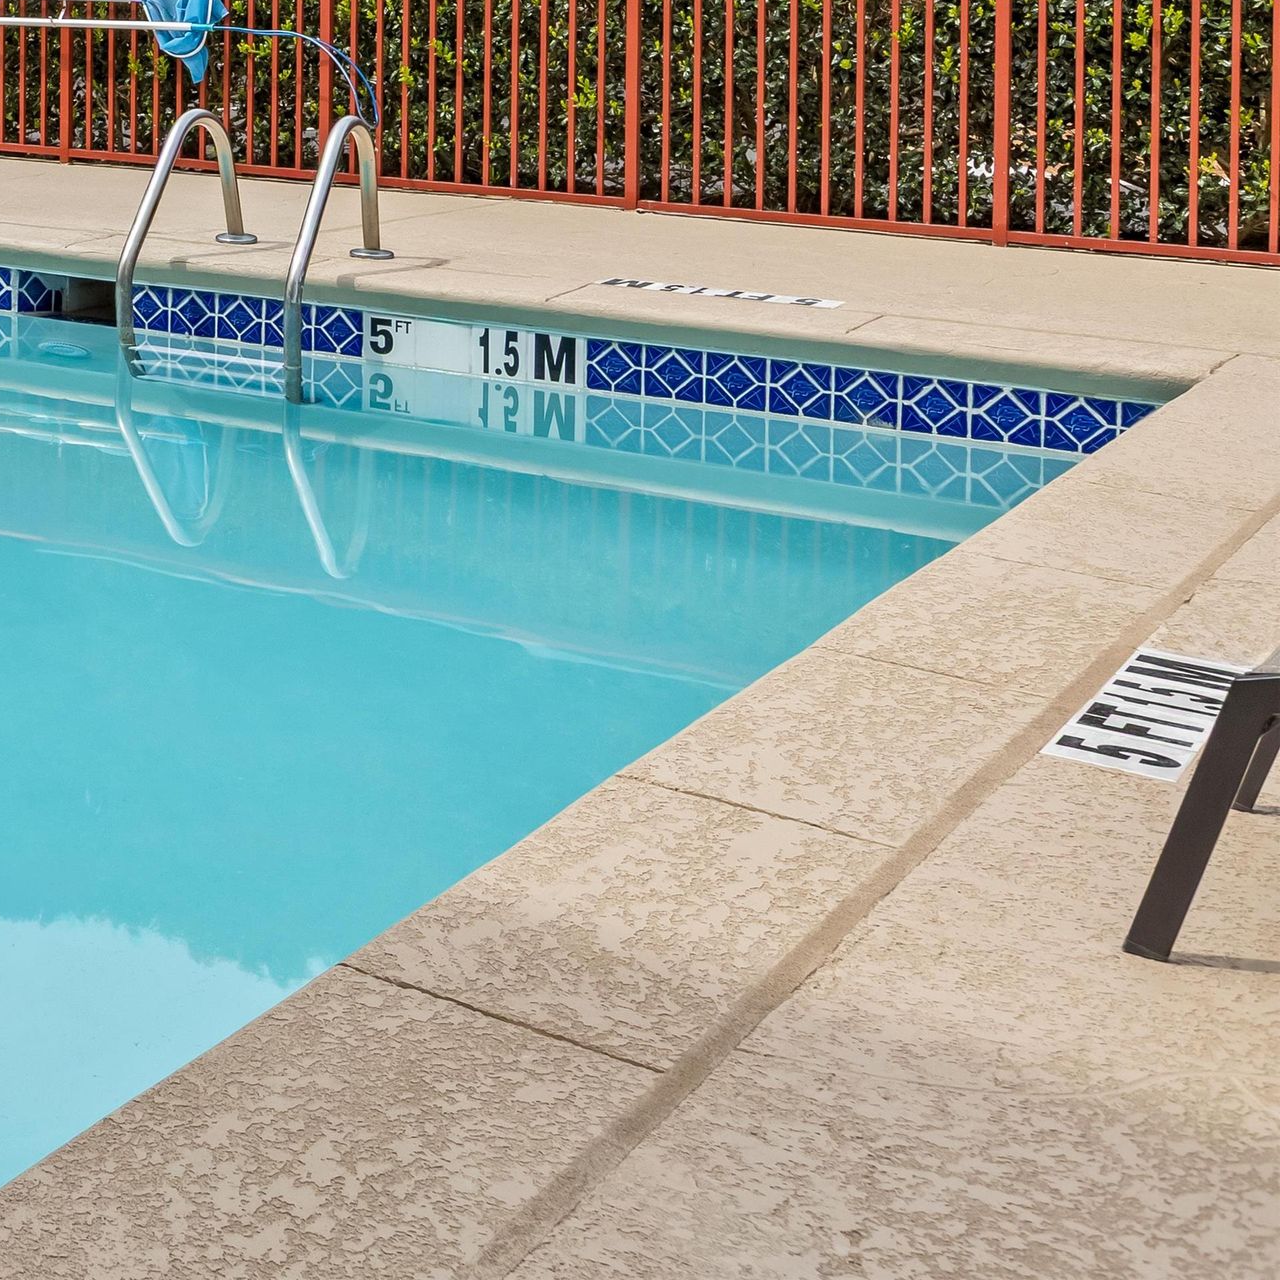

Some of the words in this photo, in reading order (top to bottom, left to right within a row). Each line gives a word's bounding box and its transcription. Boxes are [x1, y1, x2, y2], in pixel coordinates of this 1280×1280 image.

[479, 327, 520, 377] 1.5
[534, 334, 576, 384] M
[1056, 734, 1182, 768] 5
